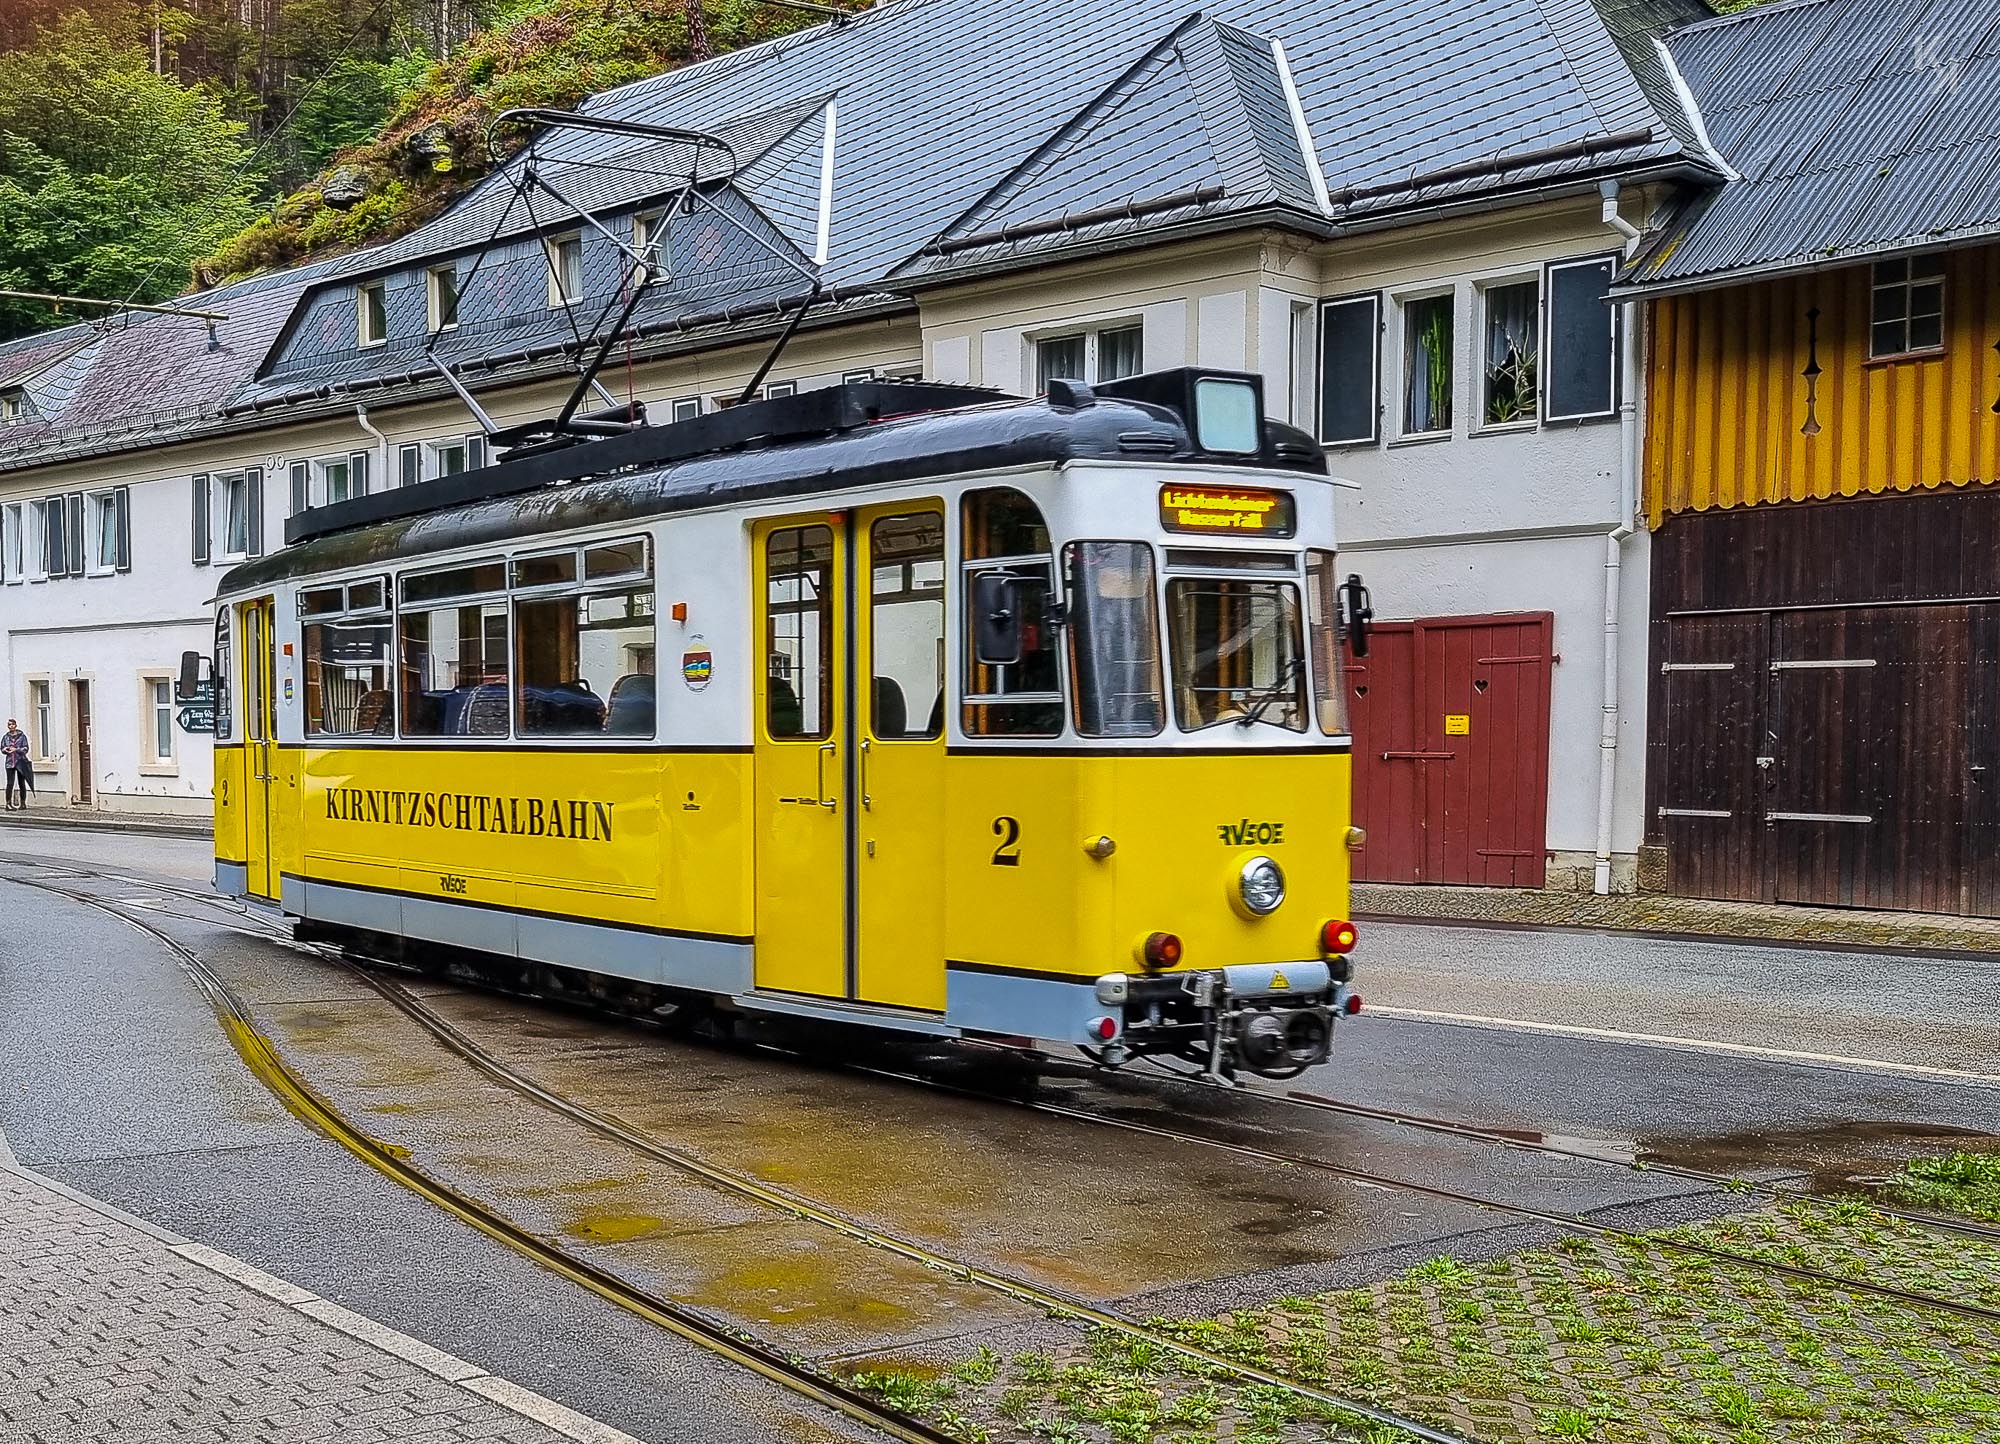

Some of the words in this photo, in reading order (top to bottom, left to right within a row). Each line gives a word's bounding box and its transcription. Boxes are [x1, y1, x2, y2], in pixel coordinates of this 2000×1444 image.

[222, 779, 228, 806] 2
[325, 787, 615, 841] KIRNITZSCHTALBAHN
[991, 816, 1021, 867] 2
